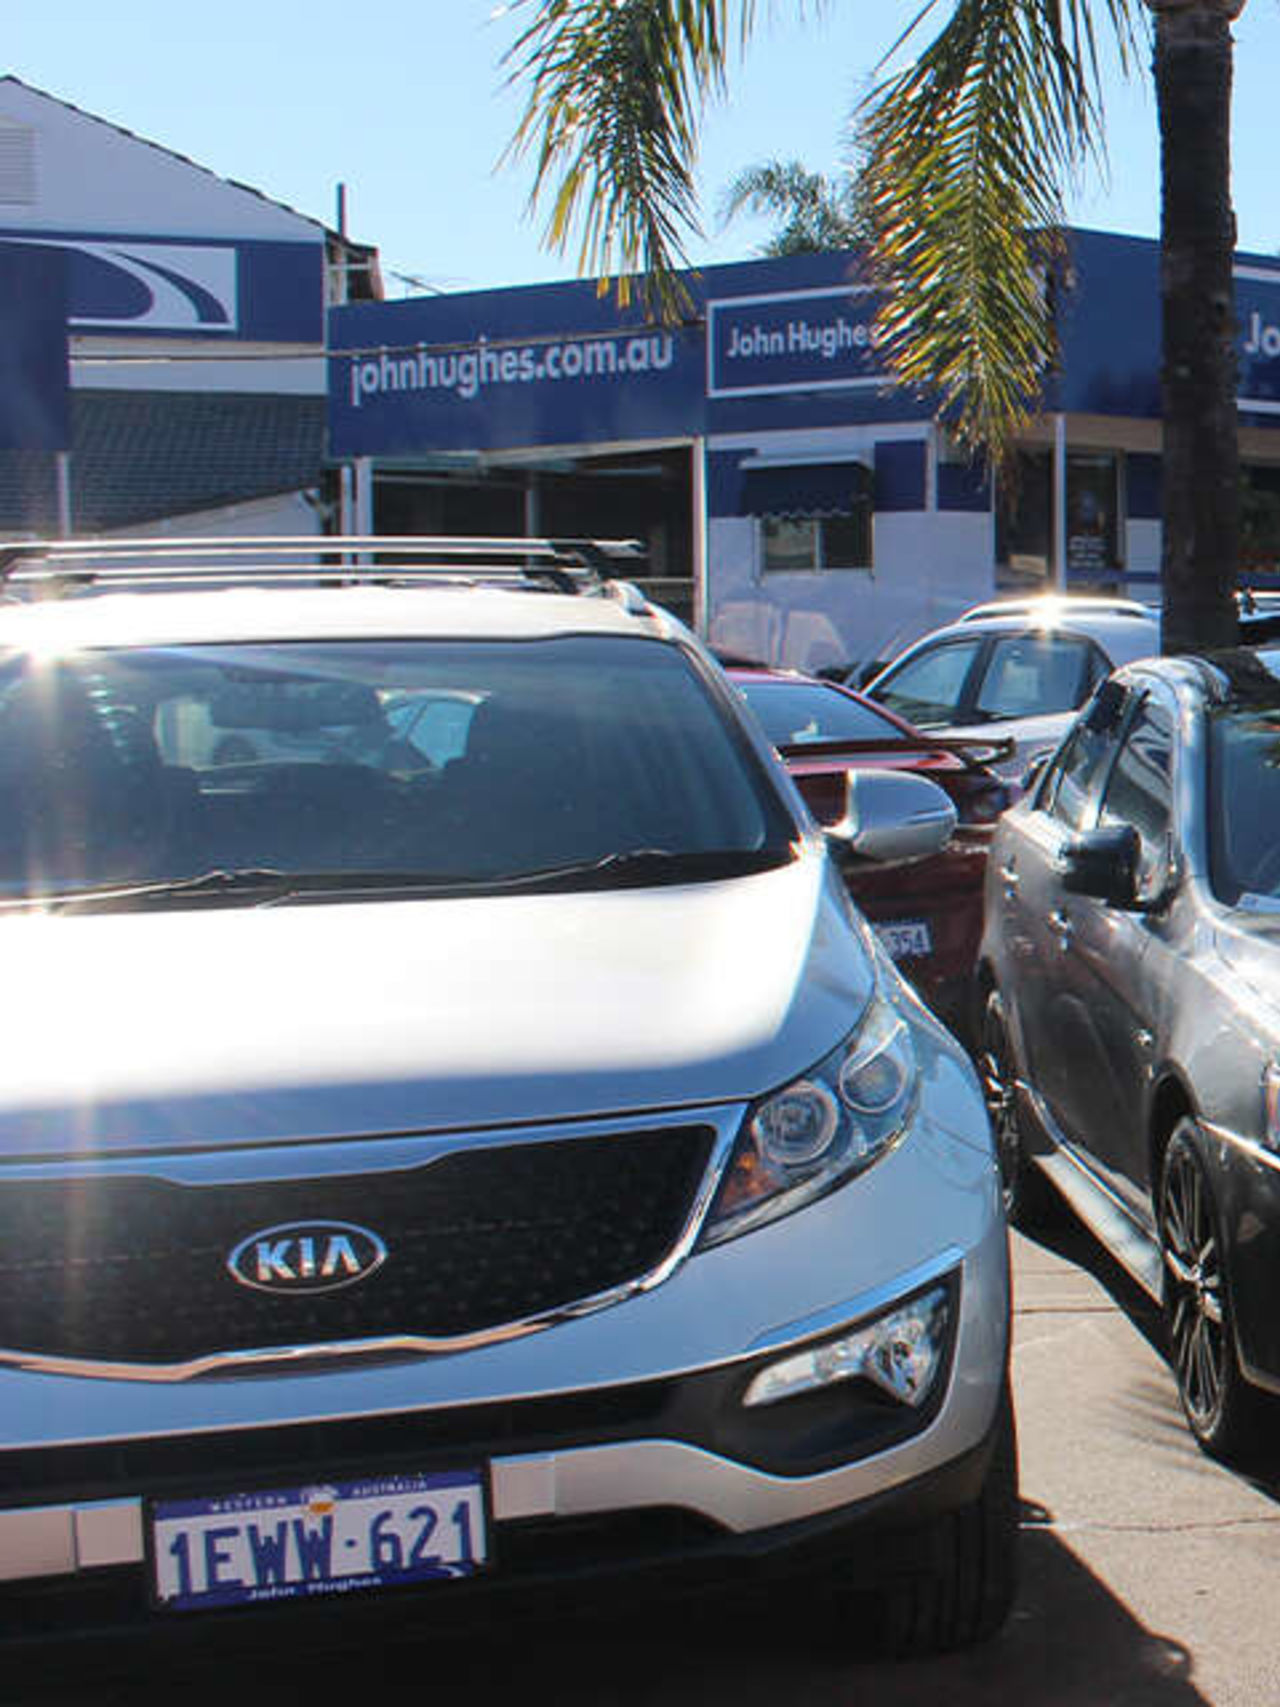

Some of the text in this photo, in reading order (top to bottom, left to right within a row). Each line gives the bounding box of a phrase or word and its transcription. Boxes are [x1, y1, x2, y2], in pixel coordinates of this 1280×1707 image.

[727, 326, 785, 358] John
[351, 334, 674, 407] johnhughes.com.au
[256, 1235, 361, 1281] KIA
